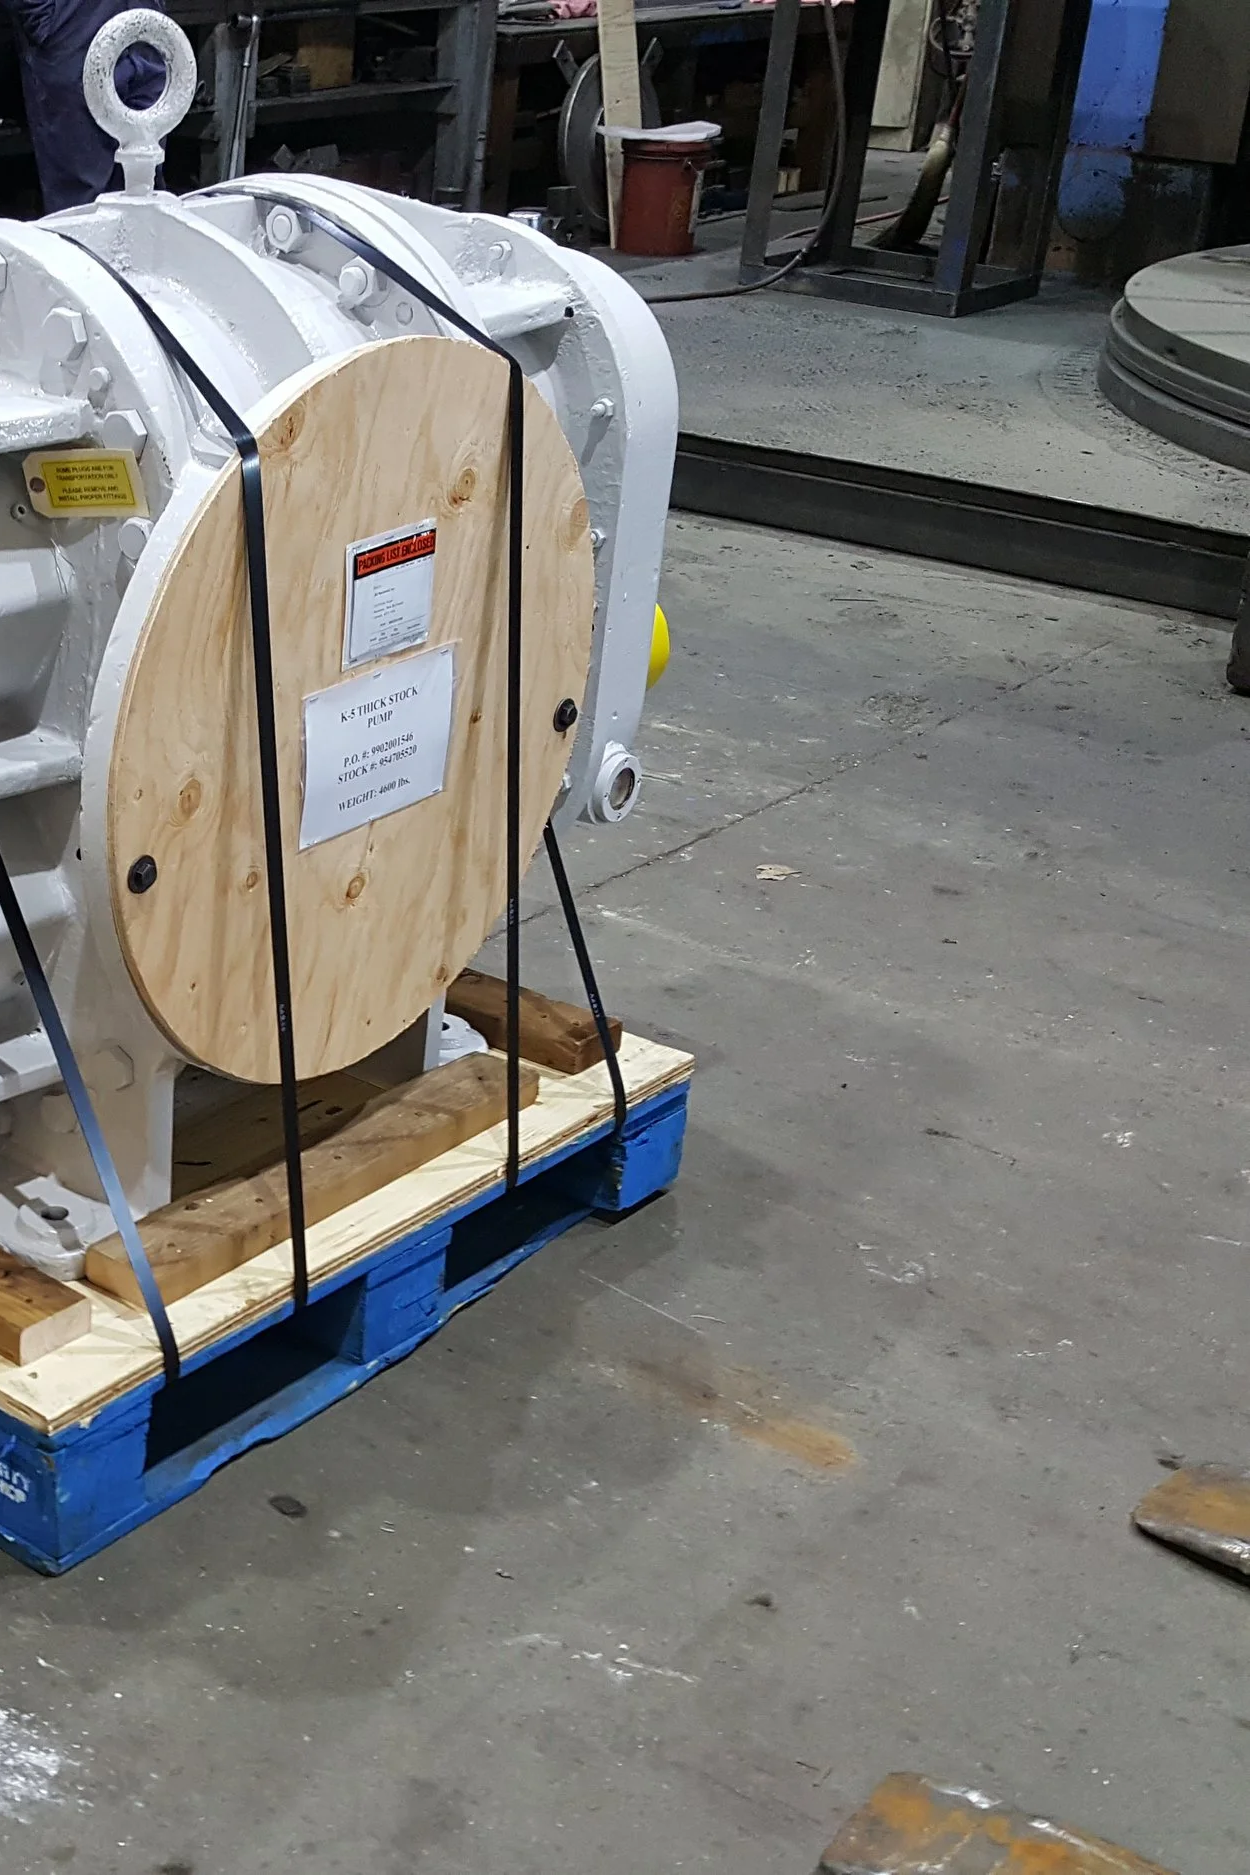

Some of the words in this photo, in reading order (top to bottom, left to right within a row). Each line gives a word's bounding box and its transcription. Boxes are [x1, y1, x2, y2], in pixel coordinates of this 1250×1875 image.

[358, 552, 385, 571] PACKING
[386, 545, 401, 562] LIST
[401, 534, 435, 557] ENCLOSED
[340, 708, 356, 723] K-5
[357, 697, 387, 717] THICK
[388, 684, 419, 705] STOCK
[367, 710, 393, 728] PUMP
[343, 753, 360, 768] P.O.
[362, 750, 370, 759] #:
[371, 732, 414, 756] 9902001546
[337, 763, 369, 785] STOCK
[369, 762, 378, 771] #:
[338, 788, 378, 811] WEIGHT:
[378, 780, 397, 795] 4600
